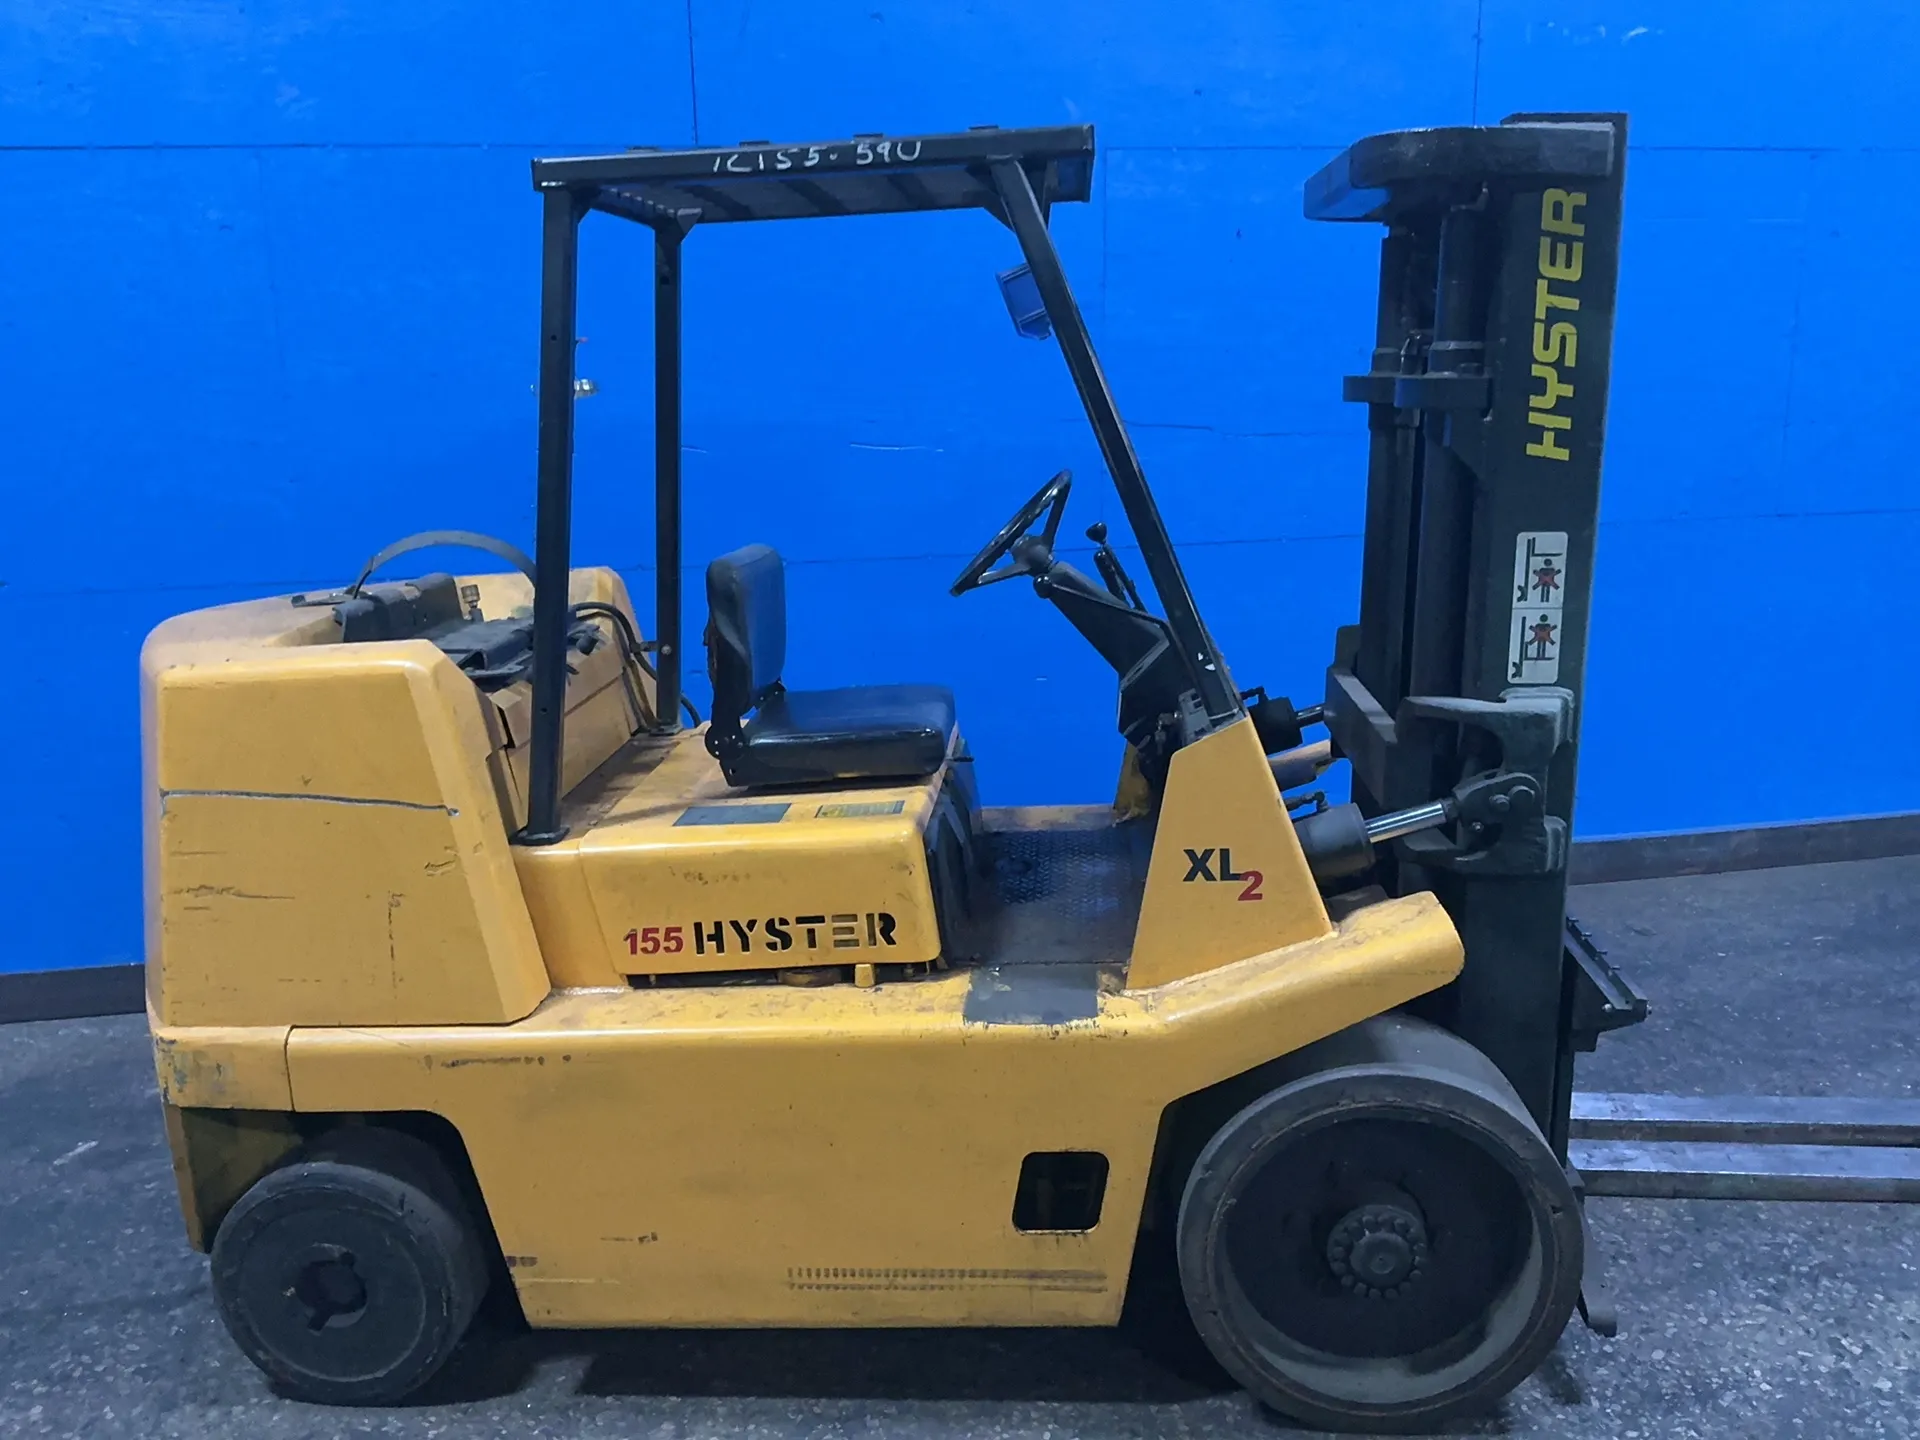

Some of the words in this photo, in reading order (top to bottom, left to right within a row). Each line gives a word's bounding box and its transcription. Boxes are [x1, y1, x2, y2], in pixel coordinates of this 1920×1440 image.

[1526, 187, 1587, 461] HYSTER
[623, 926, 684, 956] 155
[693, 912, 897, 955] HYSTER
